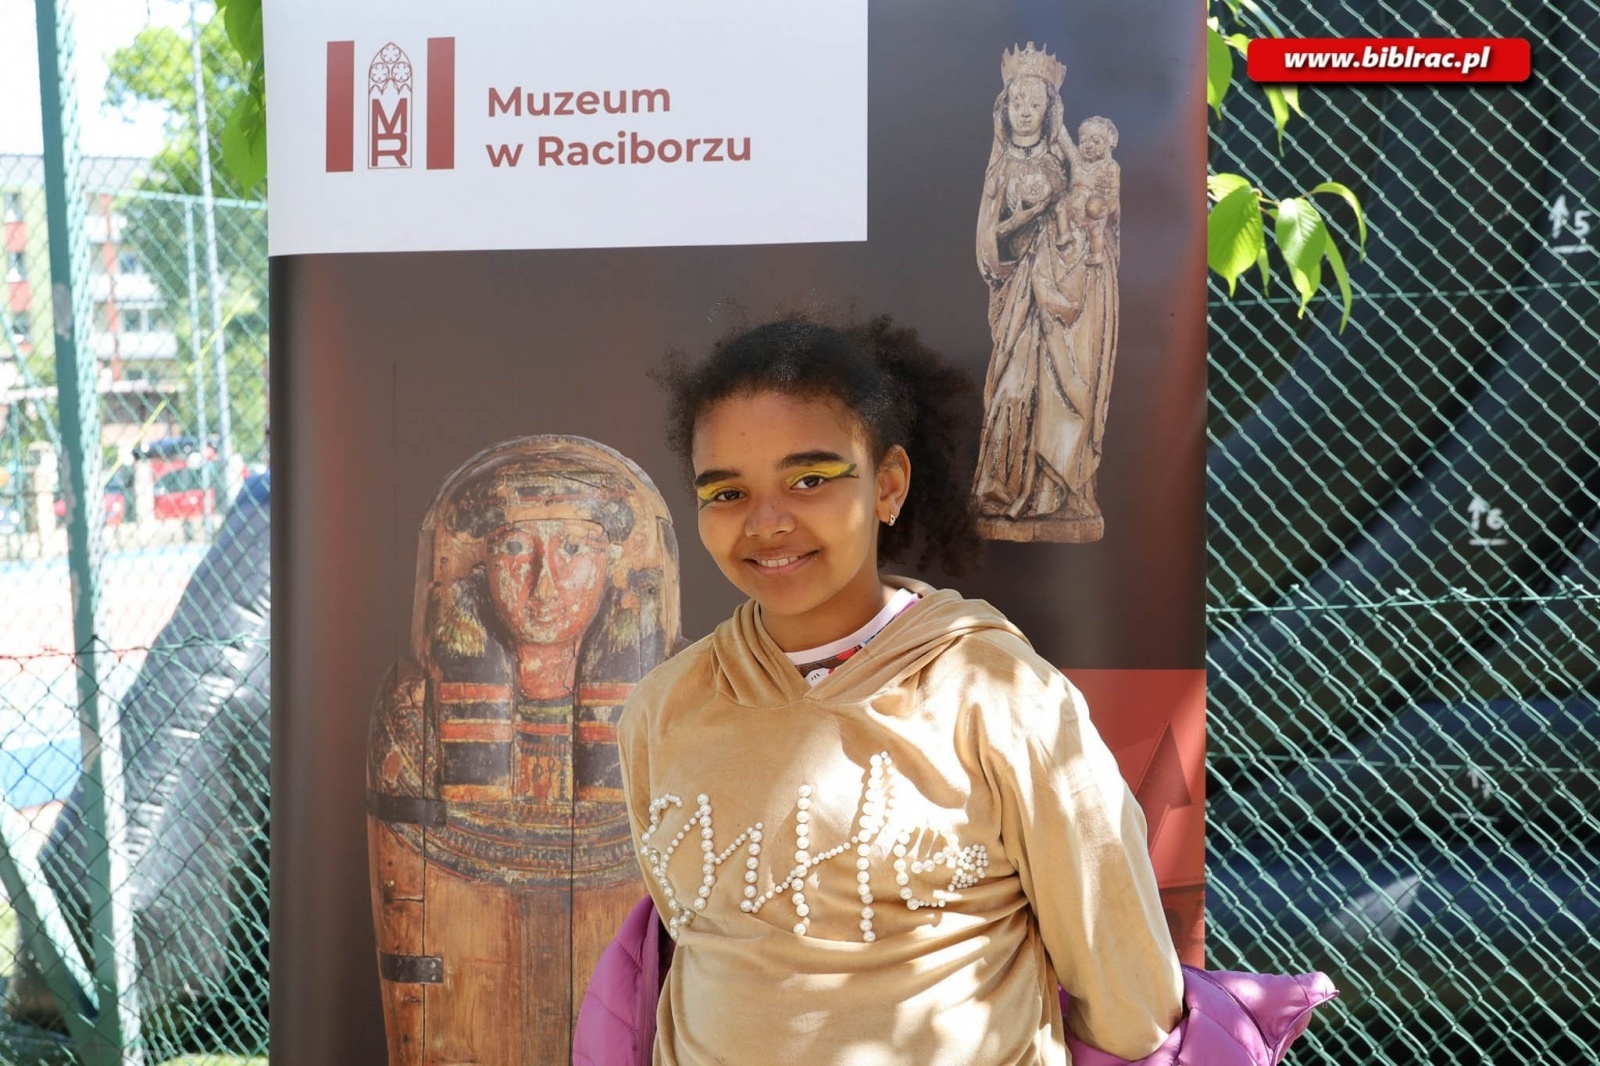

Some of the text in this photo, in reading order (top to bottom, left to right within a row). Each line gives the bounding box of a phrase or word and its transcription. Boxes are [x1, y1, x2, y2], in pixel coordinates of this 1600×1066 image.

[487, 85, 672, 118] Muzeum
[486, 131, 752, 168] w Raciborzu
[1574, 209, 1593, 237] 5
[1486, 507, 1504, 531] 6
